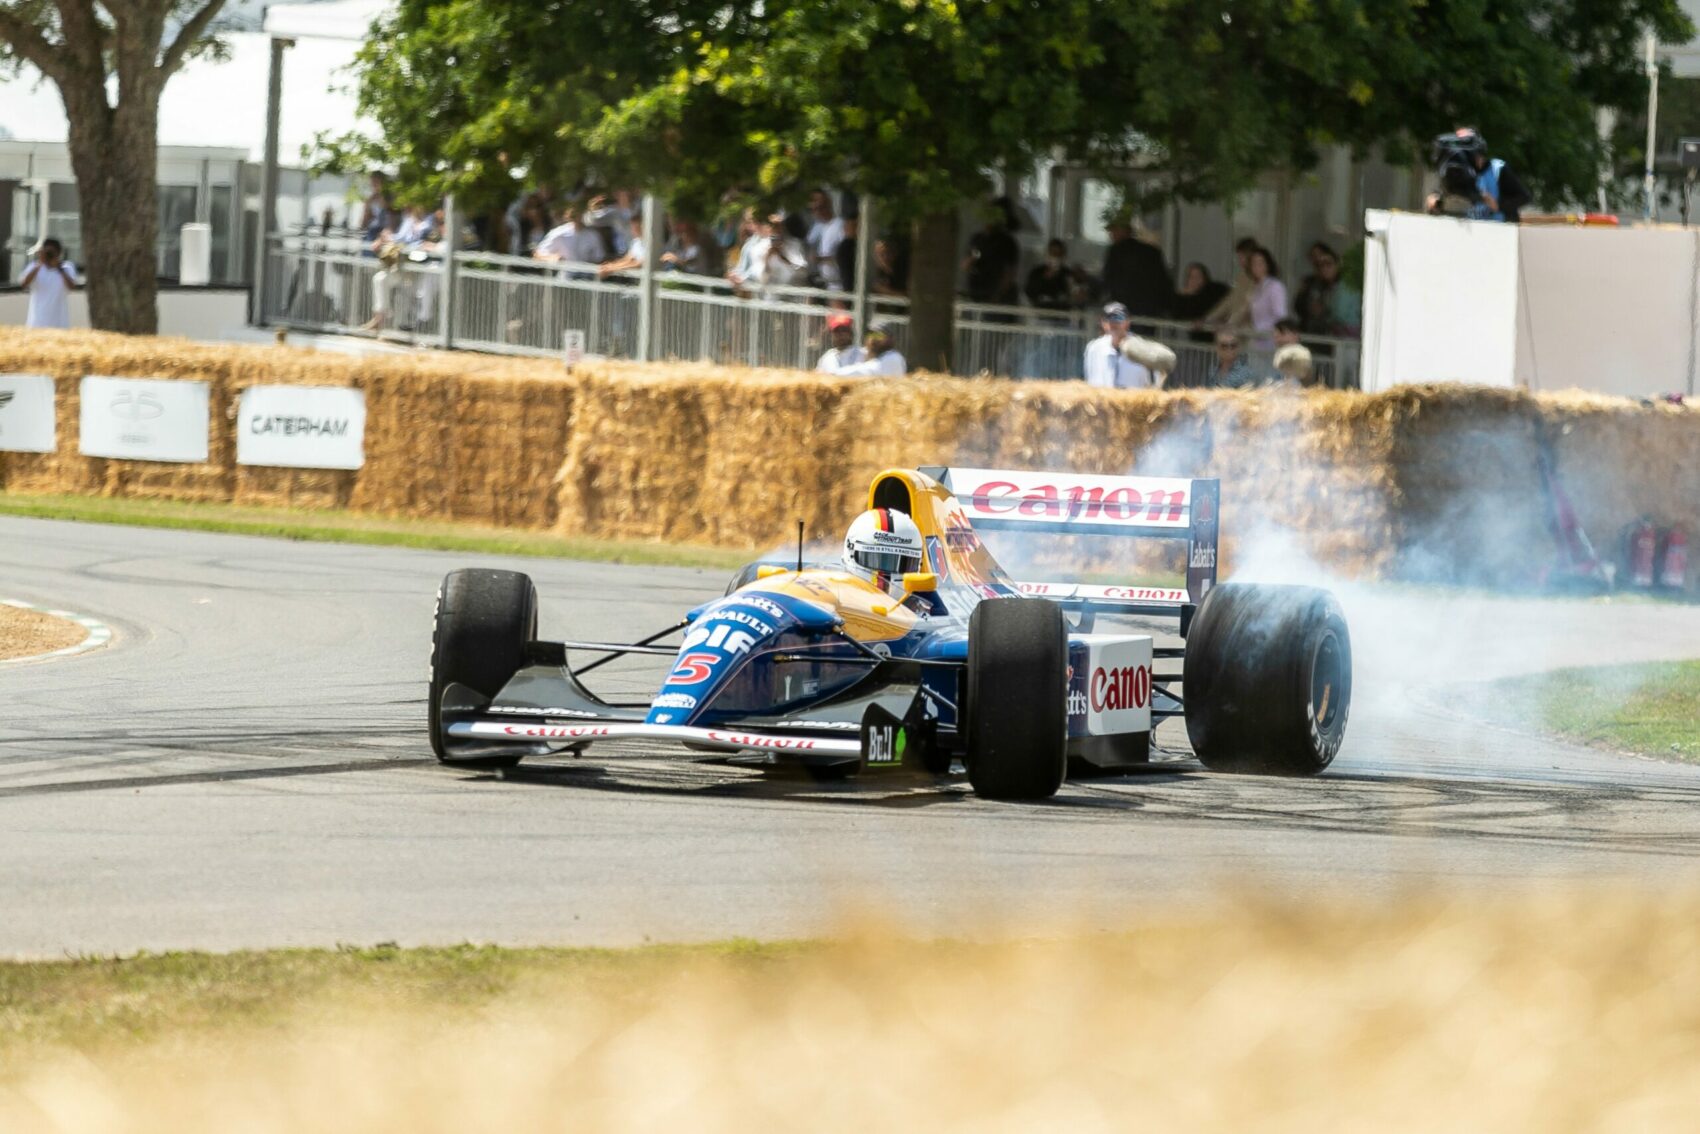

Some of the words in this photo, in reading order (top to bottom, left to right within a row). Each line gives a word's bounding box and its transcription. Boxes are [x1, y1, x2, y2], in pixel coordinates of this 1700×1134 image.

[251, 415, 349, 436] CATERHAM
[972, 481, 1185, 522] Canon
[1104, 587, 1182, 600] Canon
[665, 653, 722, 685] 5
